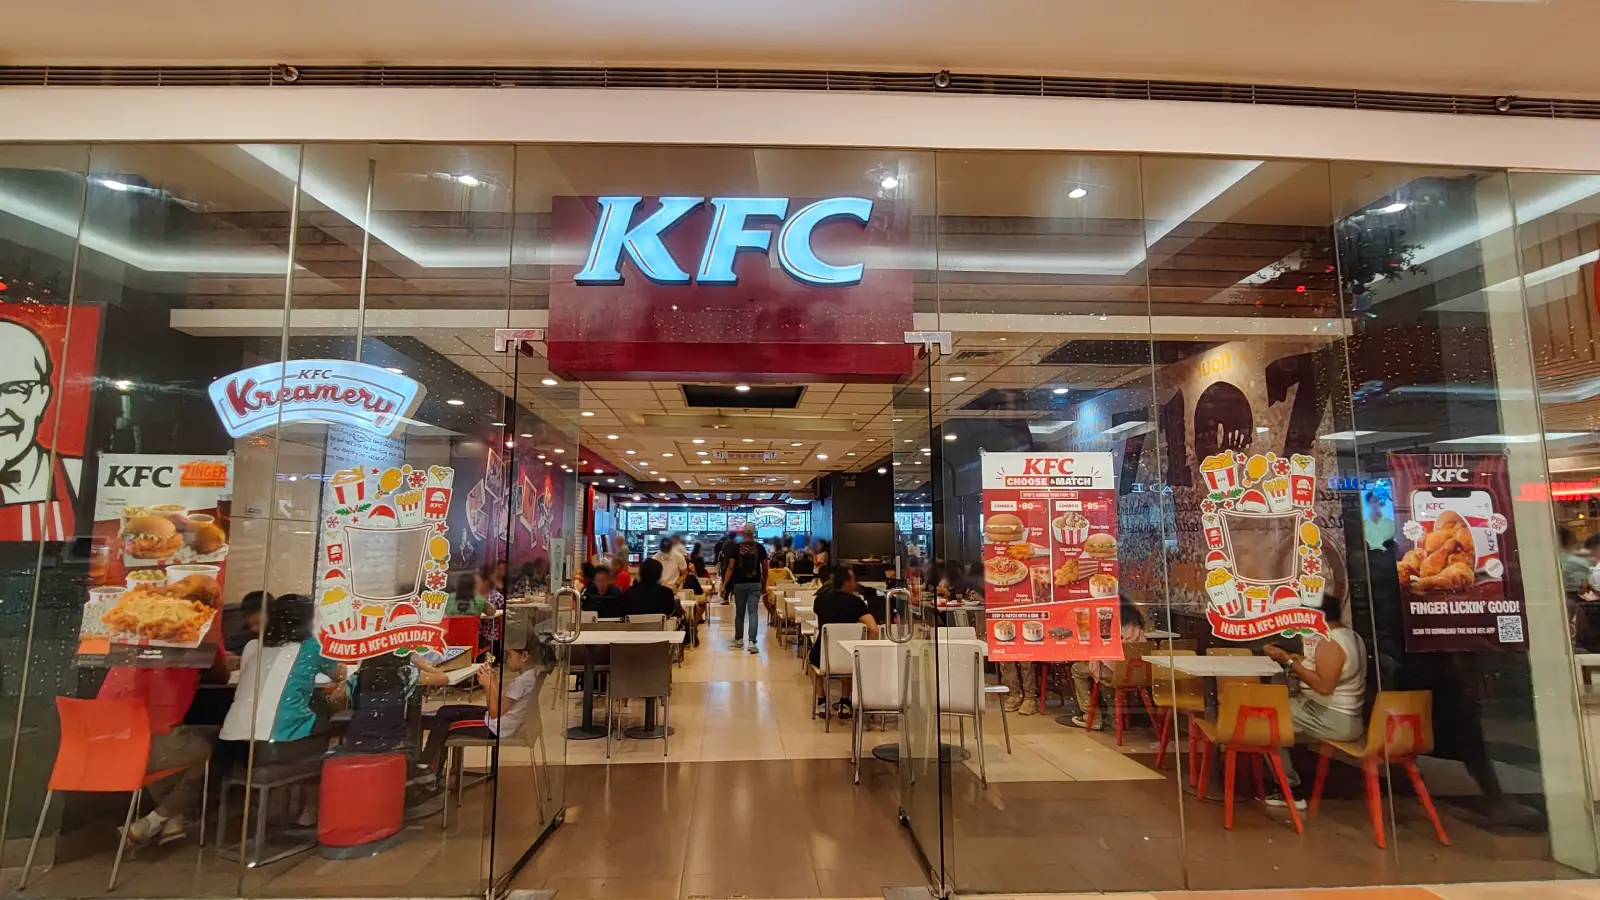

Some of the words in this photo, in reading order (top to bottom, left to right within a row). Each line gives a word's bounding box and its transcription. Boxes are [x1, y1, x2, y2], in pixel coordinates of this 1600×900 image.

[573, 196, 873, 286] KFC
[297, 369, 332, 380] KFC
[226, 378, 395, 426] Kreamery
[178, 463, 228, 480] ZINGER
[1022, 458, 1074, 475] KFC
[1430, 469, 1469, 482] KFC
[103, 465, 173, 488] KFC
[1006, 477, 1047, 486] CHOOSE
[1056, 477, 1091, 486] MATCH
[1485, 530, 1495, 551] KFC
[1410, 602, 1448, 614] FINGER
[1450, 601, 1486, 614] LICKIN'
[1488, 600, 1520, 613] GOOD!
[1220, 622, 1247, 635] HAVE
[1249, 625, 1256, 634] A
[1256, 618, 1276, 633] KFC
[1275, 613, 1317, 626] HOLIDAY
[329, 641, 356, 656] HAVE
[360, 644, 367, 654] A
[368, 638, 388, 651] KFC
[389, 630, 435, 647] HOLIDAY
